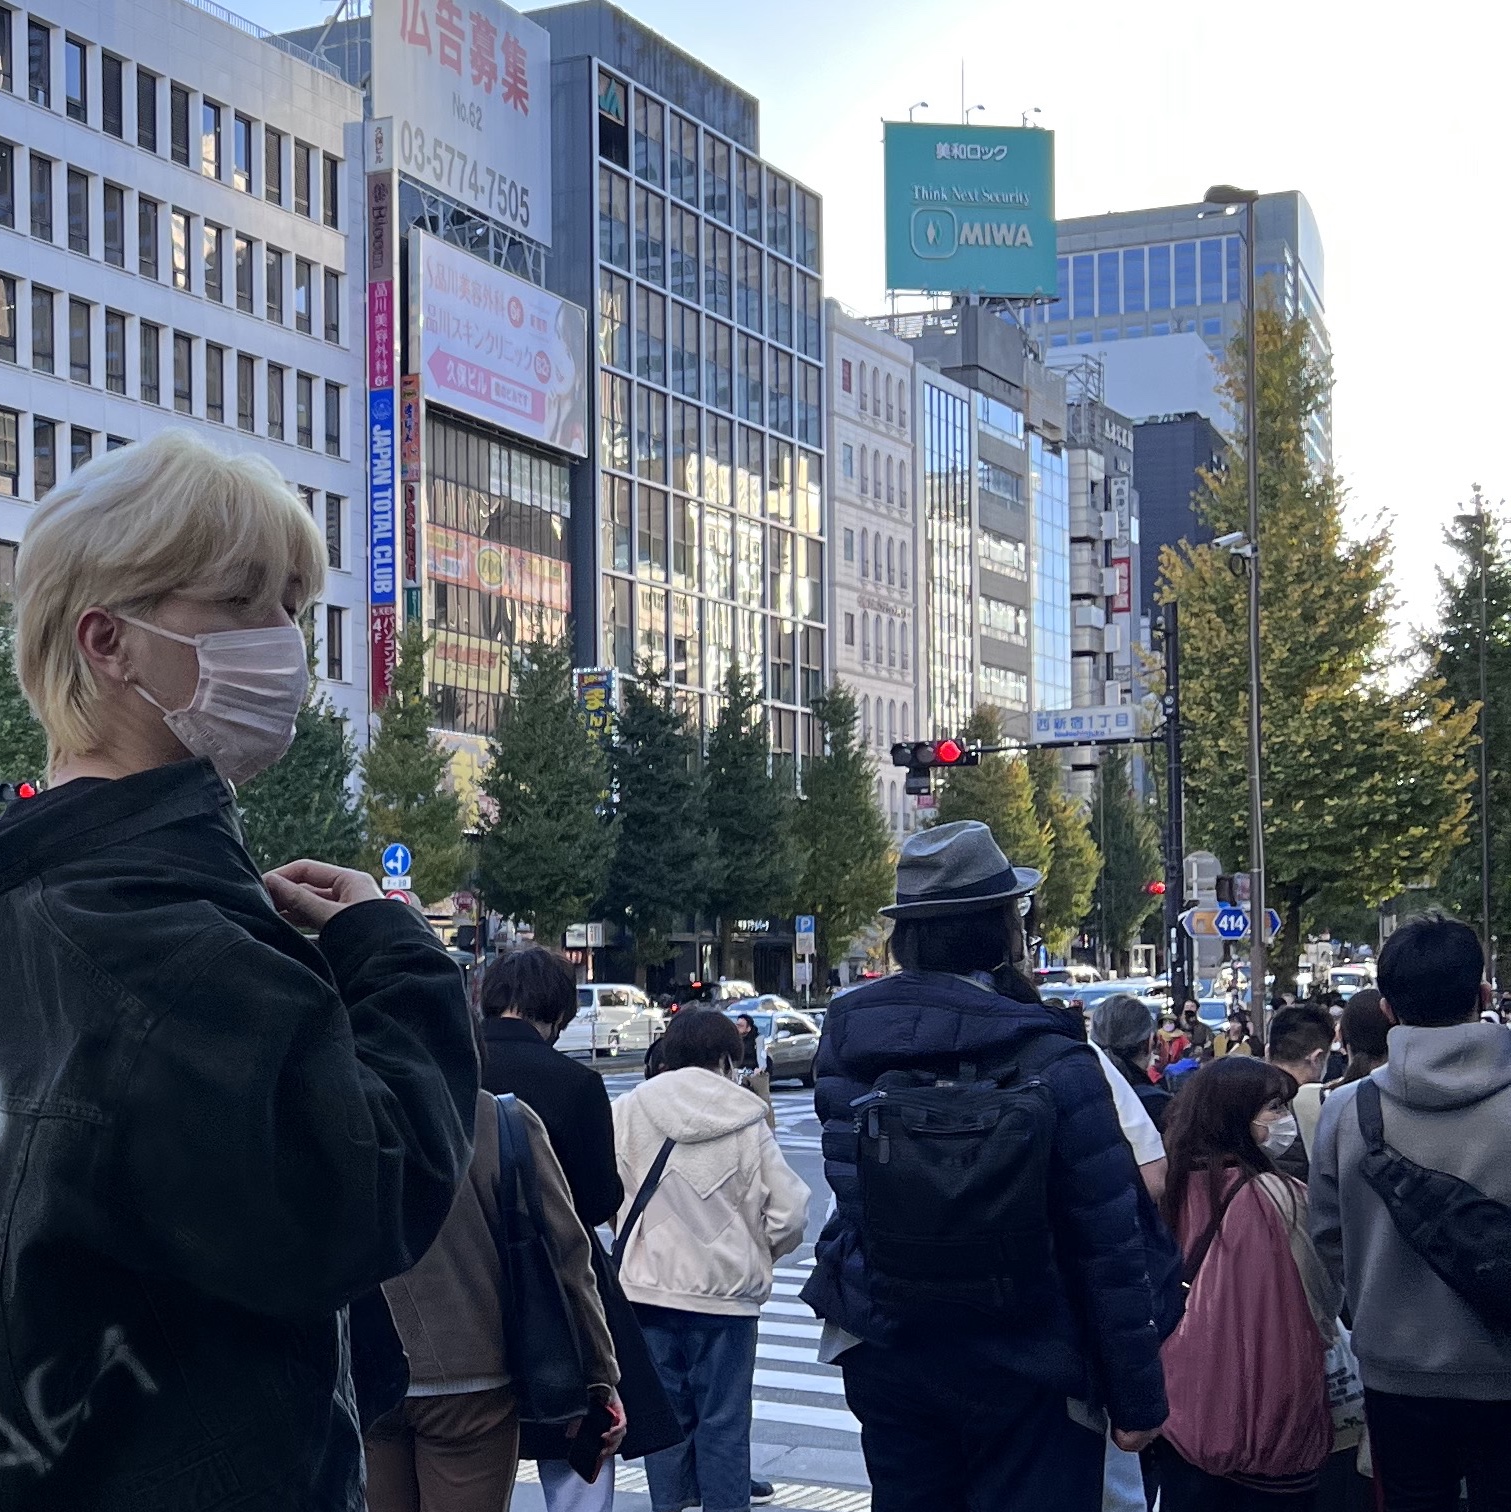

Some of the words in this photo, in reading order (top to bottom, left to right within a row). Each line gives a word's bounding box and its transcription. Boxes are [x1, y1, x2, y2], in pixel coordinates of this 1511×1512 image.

[400, 0, 529, 117] 広告募集
[451, 92, 483, 131] No.62
[400, 120, 530, 228] 03-5774-7505
[935, 142, 1008, 161] 美和ロック
[911, 184, 948, 202] Think
[951, 186, 980, 203] Next
[981, 187, 1031, 208] Security
[958, 222, 1034, 248] MIWA
[374, 282, 388, 375] 品川美容外科
[425, 303, 534, 371] 品川スキンクリニック
[374, 375, 388, 387] 6F
[372, 424, 392, 485] JAPAN
[373, 487, 392, 544] TOTAL
[373, 545, 393, 594] CLUB
[1218, 915, 1245, 931] 414
